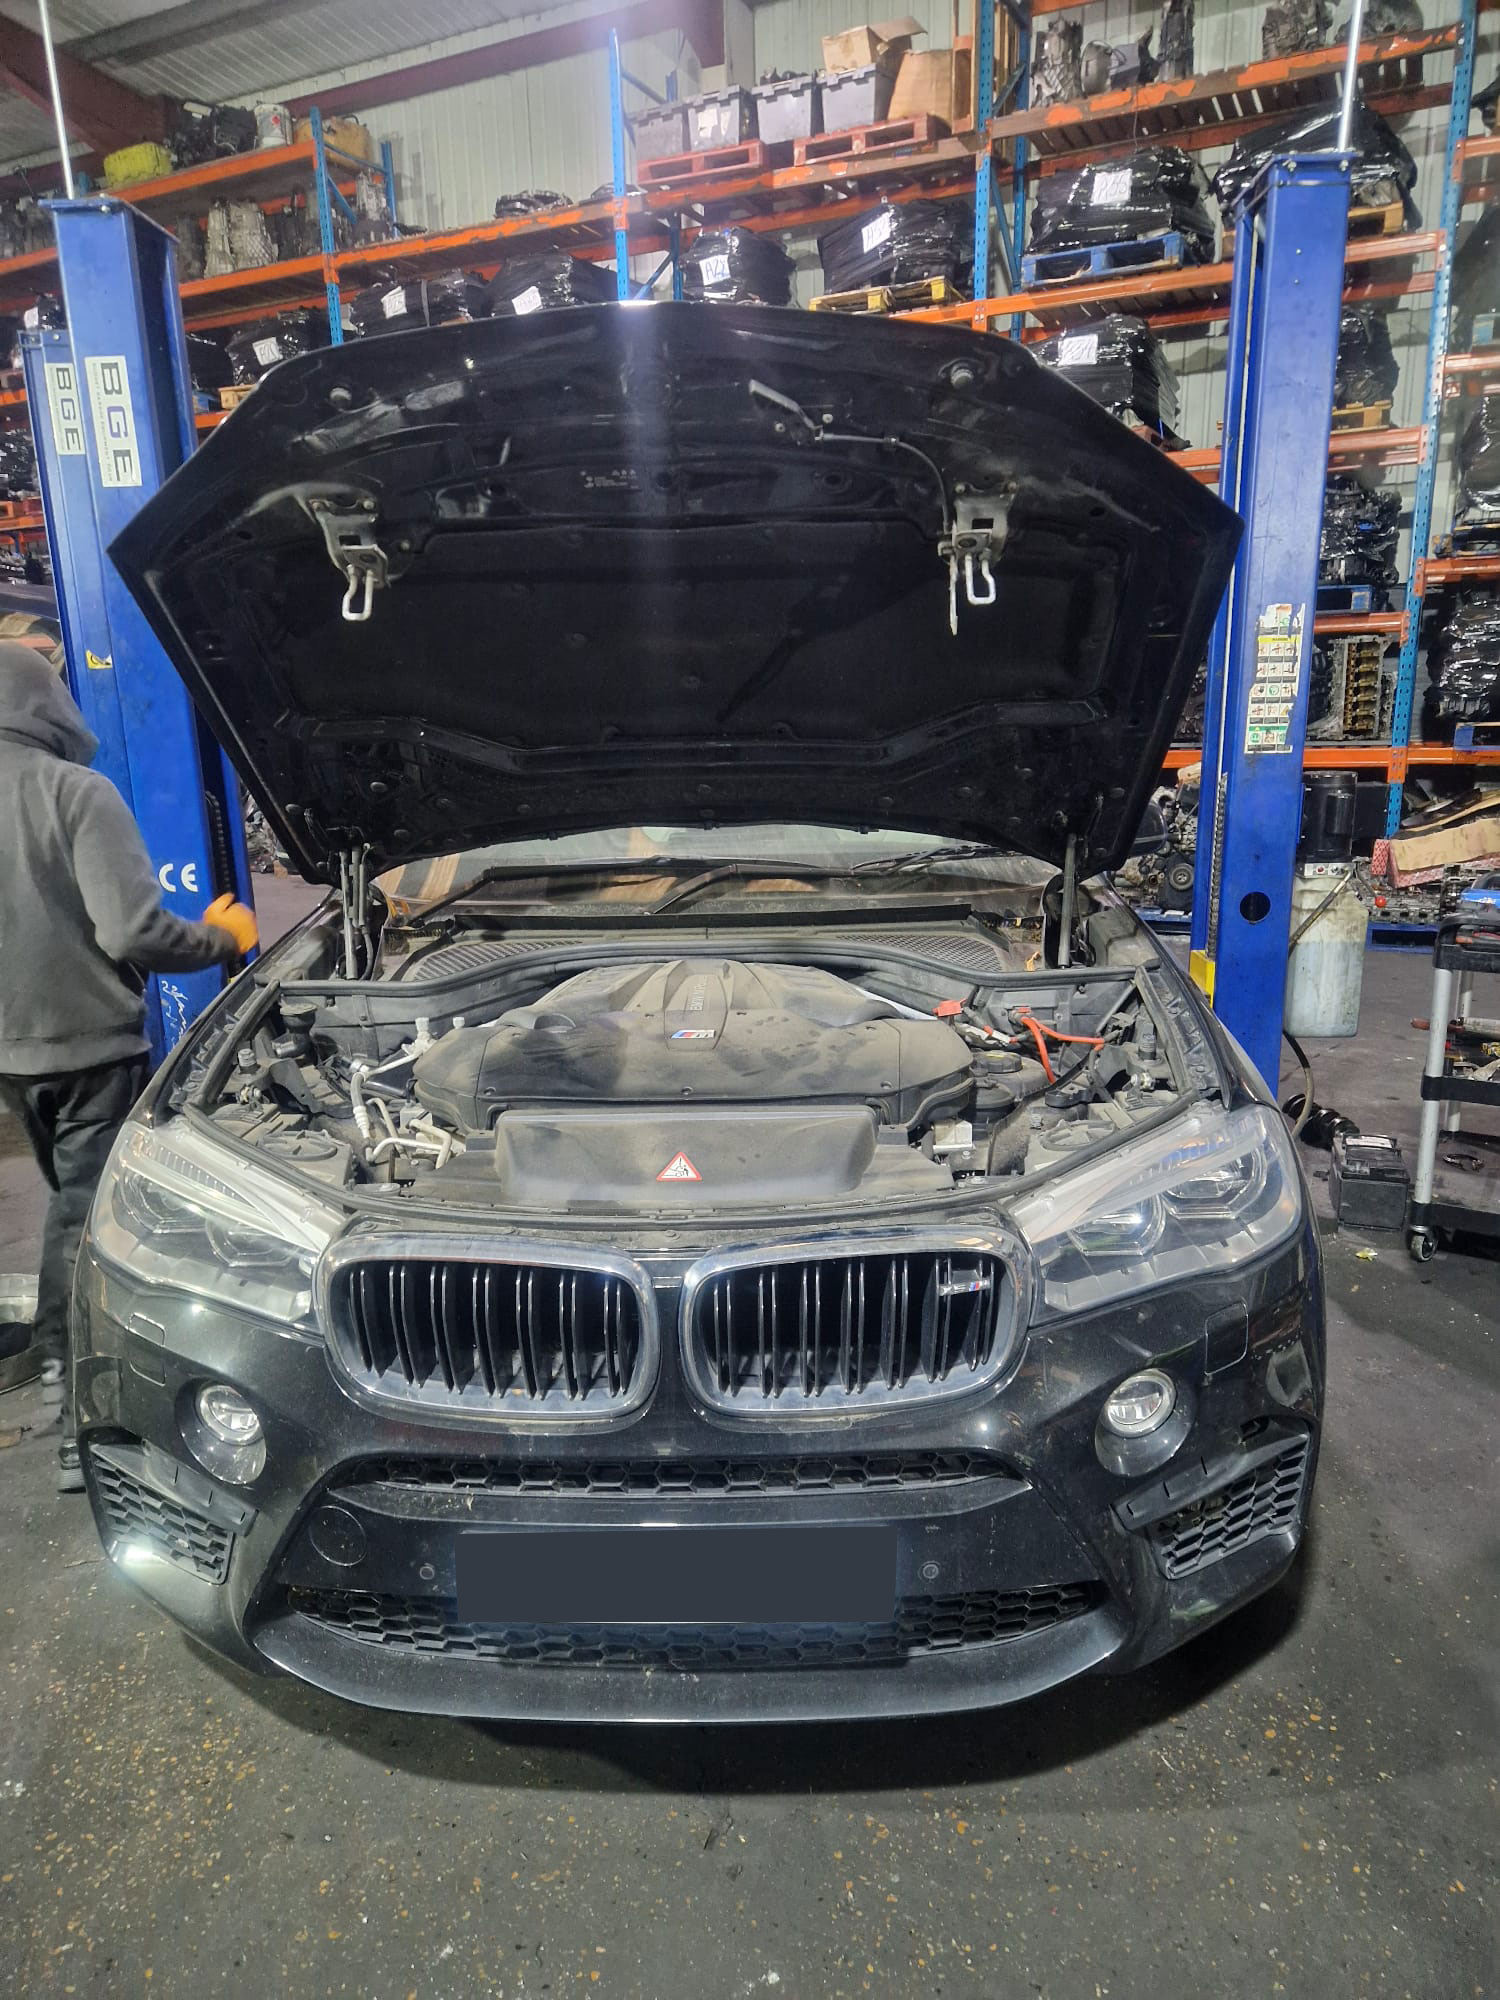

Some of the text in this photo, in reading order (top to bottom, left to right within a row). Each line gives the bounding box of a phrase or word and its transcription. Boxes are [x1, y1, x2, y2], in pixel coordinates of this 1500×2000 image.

[56, 367, 81, 451] BGE
[101, 362, 135, 482] BGE
[158, 863, 199, 892] CE
